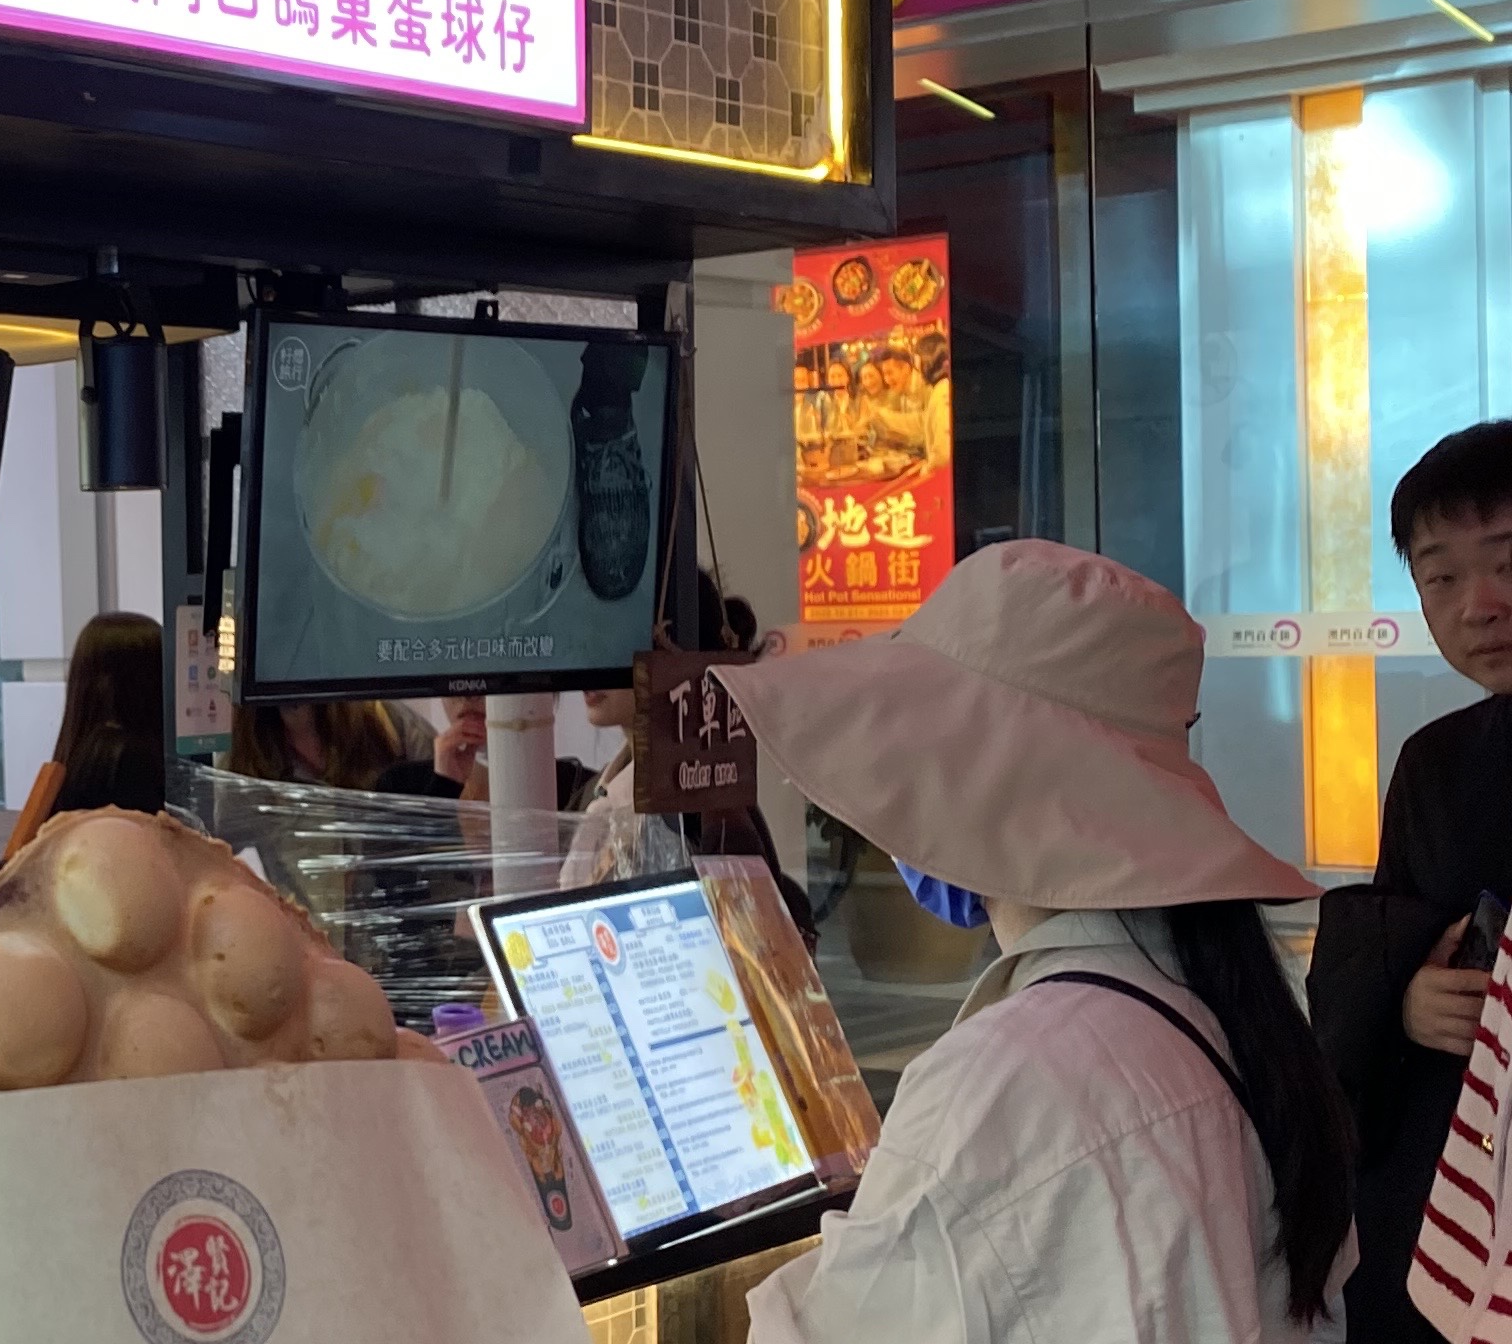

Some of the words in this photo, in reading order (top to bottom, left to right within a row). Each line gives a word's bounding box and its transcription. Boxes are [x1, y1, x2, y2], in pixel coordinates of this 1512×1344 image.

[816, 490, 934, 551] 地道
[804, 549, 921, 589] 火鍋街
[378, 635, 554, 663] 要配合多元化口味而改變
[449, 679, 487, 692] KONKA
[679, 759, 712, 791] Order
[714, 762, 738, 787] area
[458, 1029, 536, 1070] CREAM
